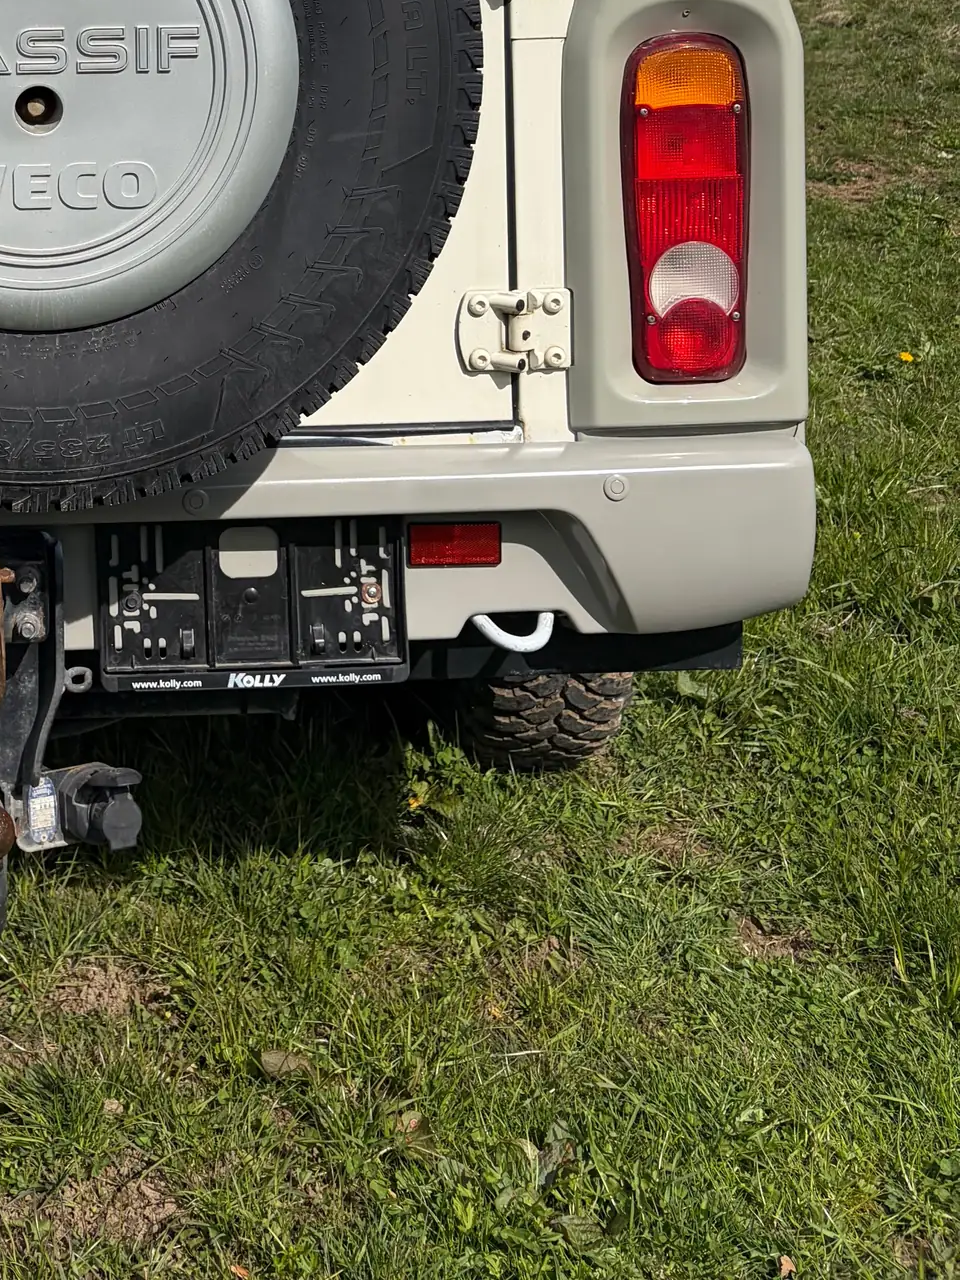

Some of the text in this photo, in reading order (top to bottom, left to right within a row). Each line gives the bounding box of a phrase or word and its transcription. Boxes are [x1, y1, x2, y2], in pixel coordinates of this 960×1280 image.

[404, 44, 428, 96] LT
[118, 417, 168, 451] LT
[131, 672, 382, 690] www.kolly.com KOLLY www.kolly.com
